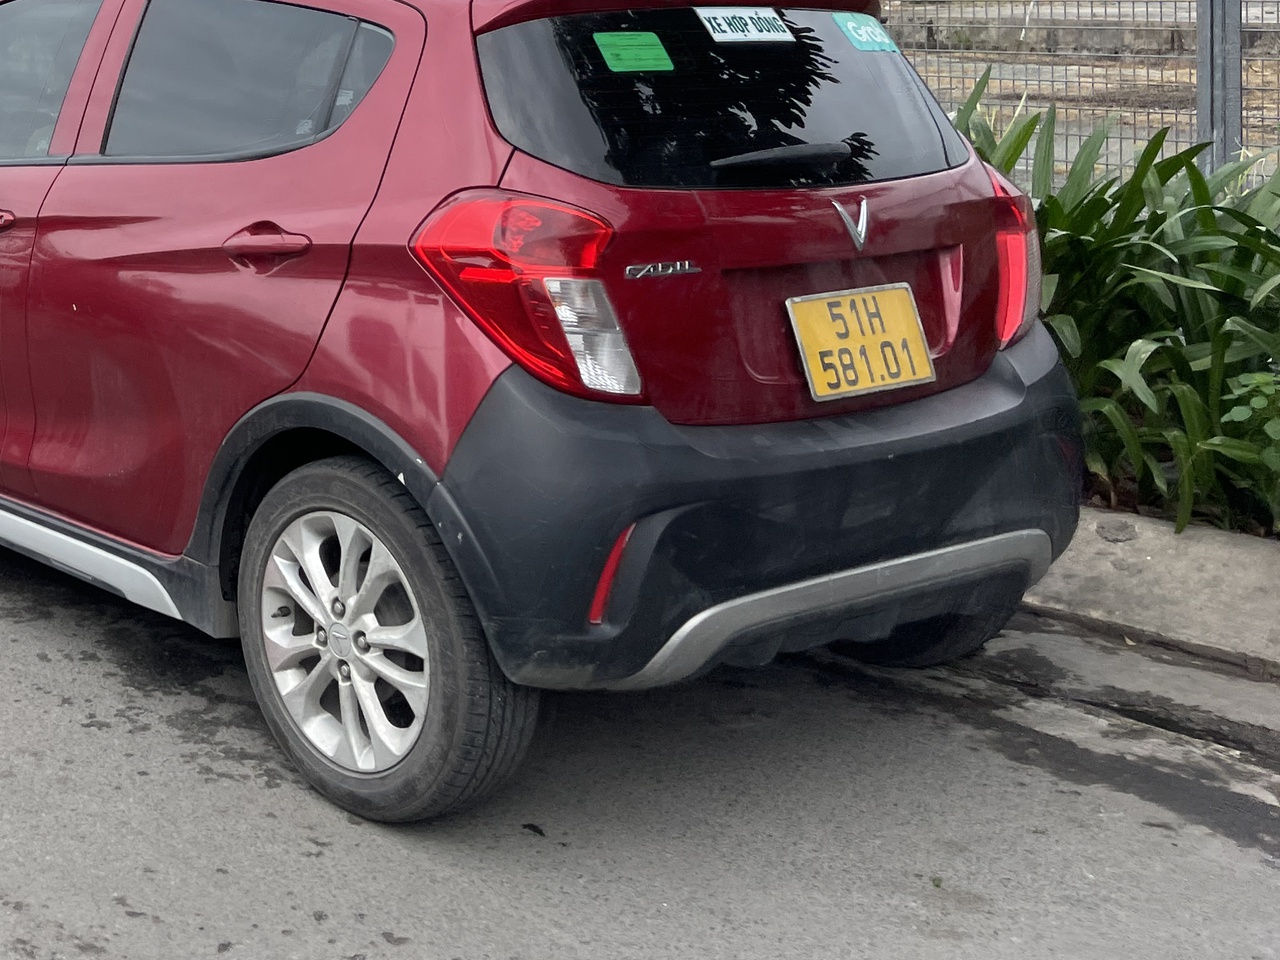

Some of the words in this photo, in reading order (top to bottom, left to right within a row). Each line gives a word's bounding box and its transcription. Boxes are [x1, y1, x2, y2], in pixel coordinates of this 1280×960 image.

[703, 16, 727, 34] XE
[726, 13, 750, 37] HỢP
[846, 20, 890, 44] Grab
[826, 295, 887, 340] 51H
[818, 338, 917, 390] 581.01
